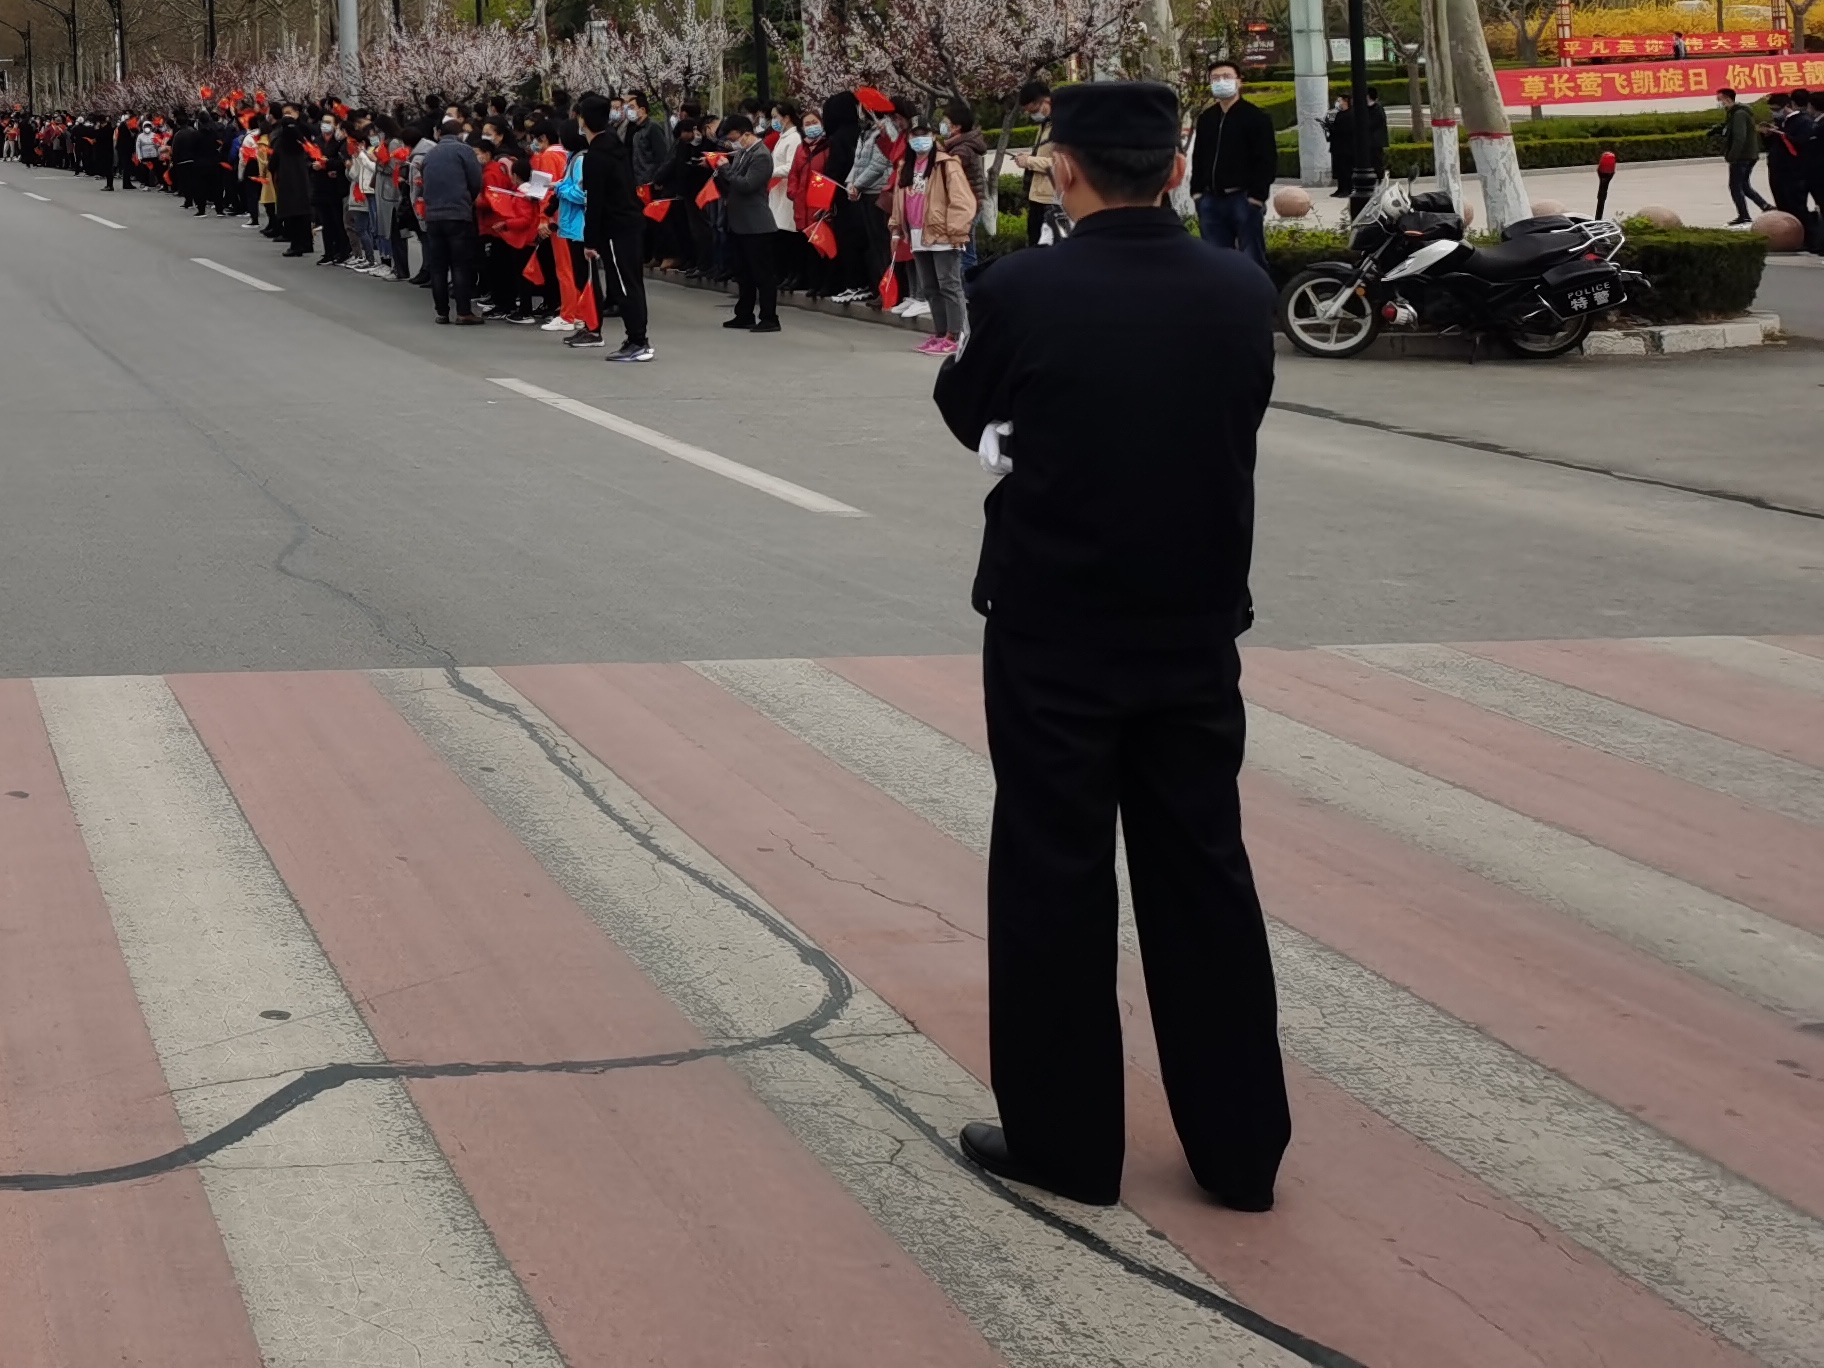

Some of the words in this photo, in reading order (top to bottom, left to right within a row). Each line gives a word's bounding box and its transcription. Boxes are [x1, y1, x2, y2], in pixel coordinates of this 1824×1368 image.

[1521, 68, 1709, 100] 草长莺飞凯旋日
[1567, 281, 1611, 300] POLICE
